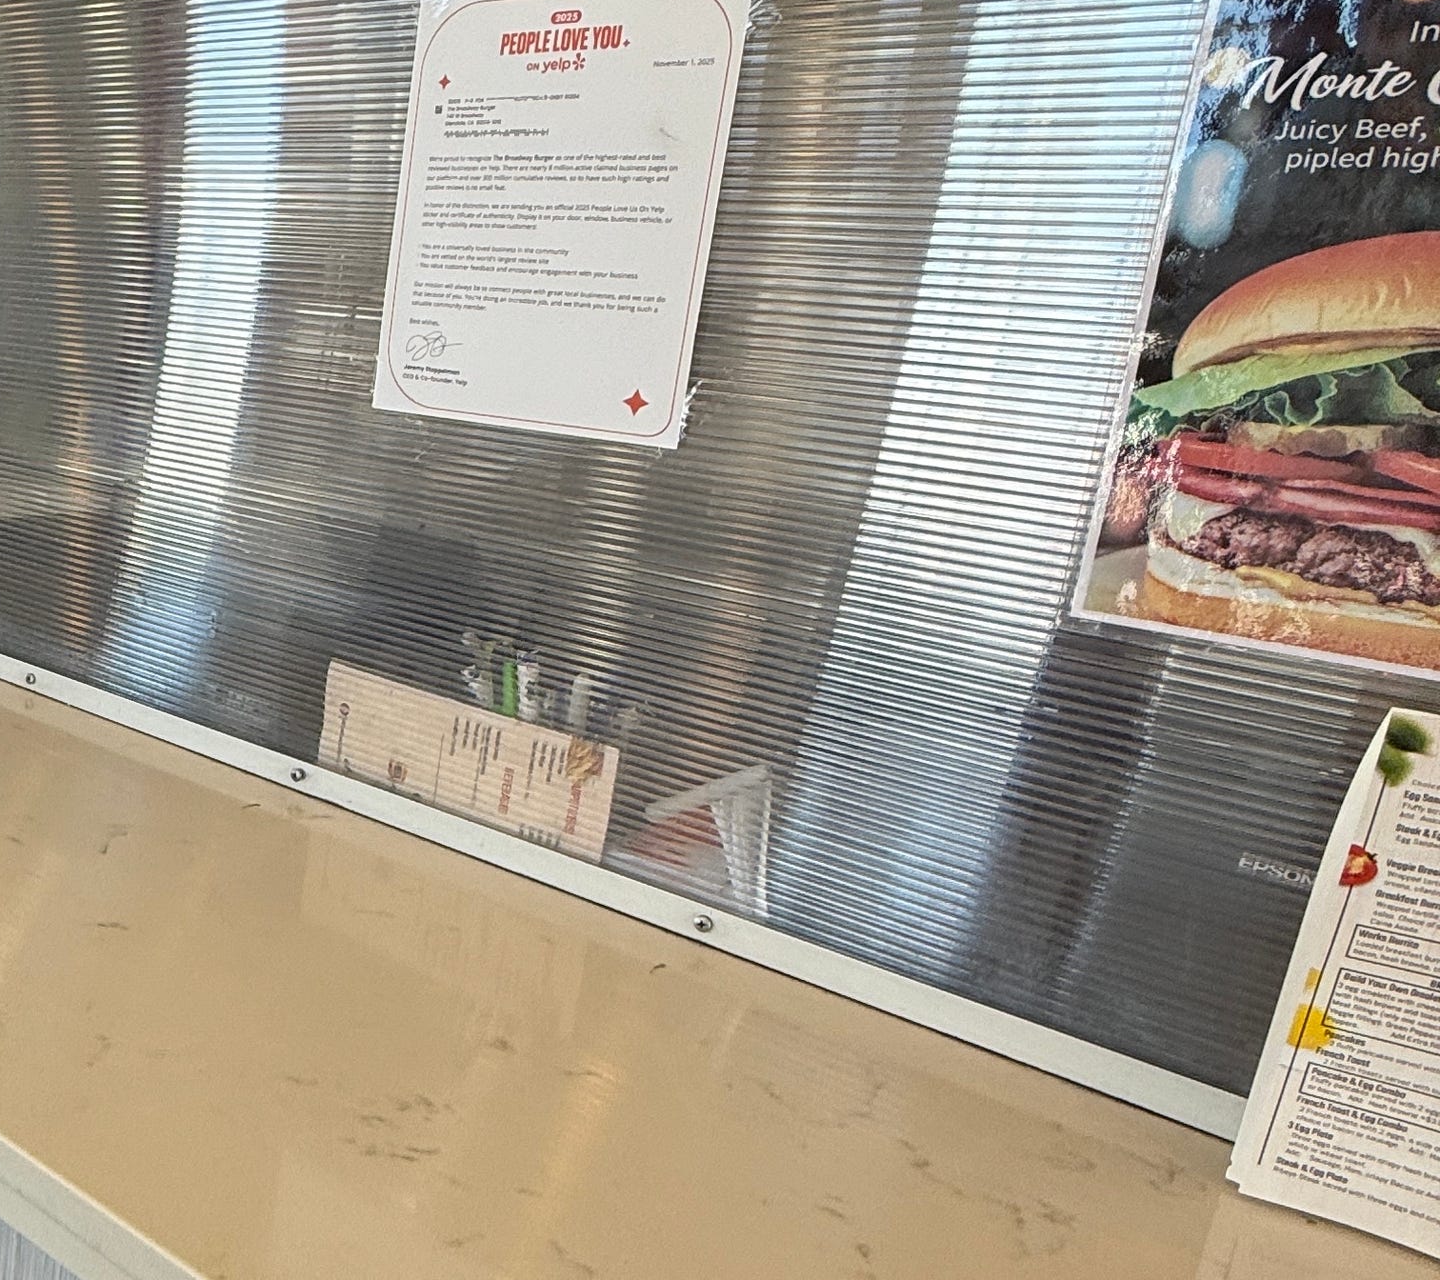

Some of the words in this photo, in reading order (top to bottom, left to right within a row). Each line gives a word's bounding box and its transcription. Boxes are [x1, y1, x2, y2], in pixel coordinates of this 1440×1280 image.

[554, 11, 579, 23] 2025
[499, 30, 553, 56] PEOPLE
[552, 27, 590, 52] LOVE
[526, 63, 540, 72] ON
[541, 57, 571, 74] yelp
[652, 59, 689, 68] November
[697, 57, 715, 66] 2025
[1240, 52, 1417, 110] Monte
[1274, 120, 1347, 144] Juicy
[1355, 116, 1428, 143] Beef,
[1284, 147, 1373, 174] pipled
